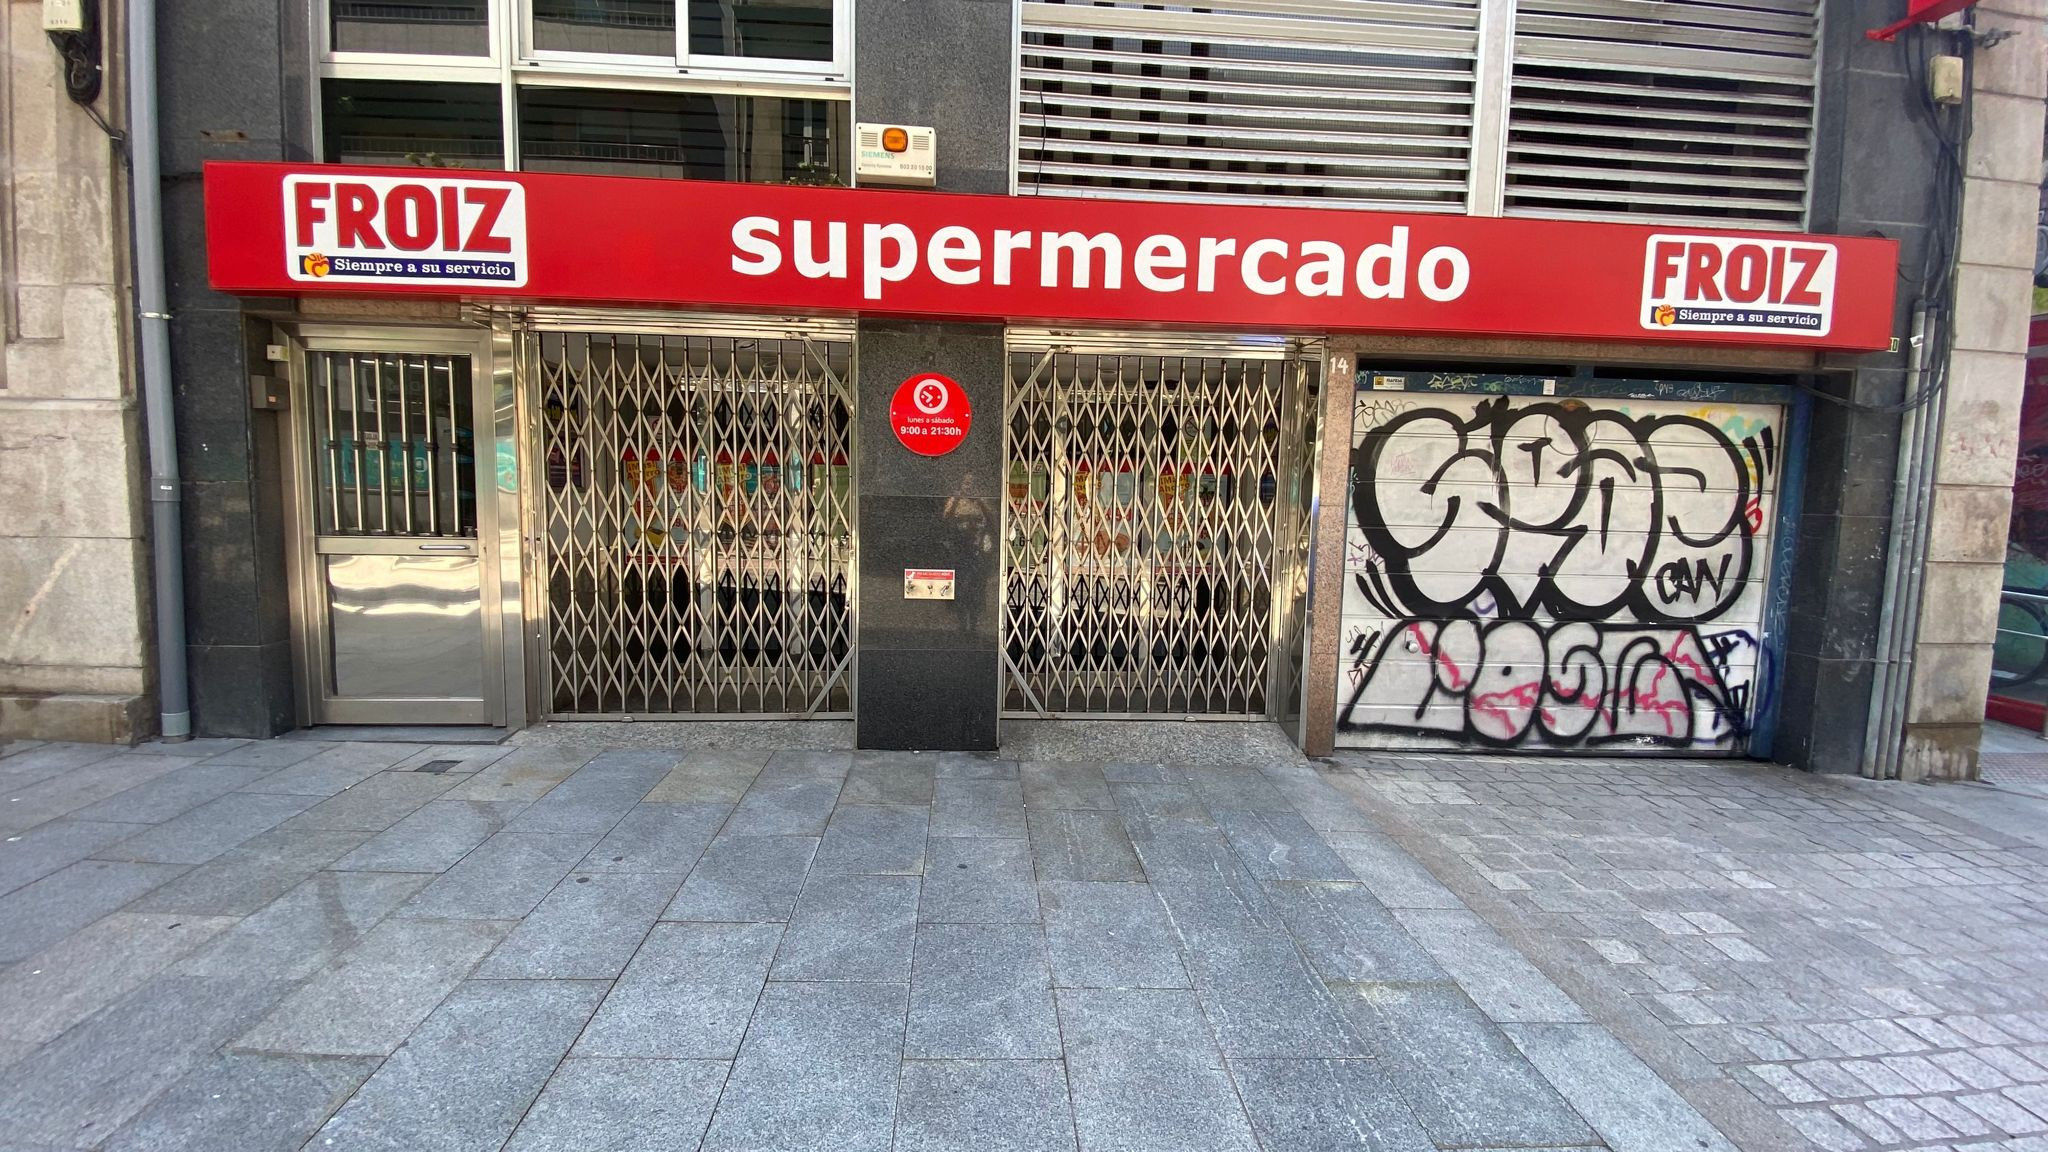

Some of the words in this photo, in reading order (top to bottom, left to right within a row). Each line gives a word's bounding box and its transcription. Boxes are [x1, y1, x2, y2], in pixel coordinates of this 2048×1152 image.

[861, 151, 895, 159] SIEMENS
[294, 181, 512, 254] FROIZ
[334, 258, 403, 275] Siempre
[407, 264, 417, 273] a
[422, 264, 440, 274] su
[445, 263, 511, 276] servicio
[731, 215, 1471, 303] supermercado
[1650, 241, 1829, 307] FROIZ
[1679, 308, 1734, 325] Siempre
[1736, 313, 1745, 322] a
[1749, 313, 1764, 323] su
[1767, 313, 1819, 326] servicio
[1330, 356, 1349, 375] 14
[907, 416, 924, 424] lunes
[931, 416, 955, 424] sábado
[900, 426, 920, 435] 9:00
[1654, 553, 1733, 605] CAN
